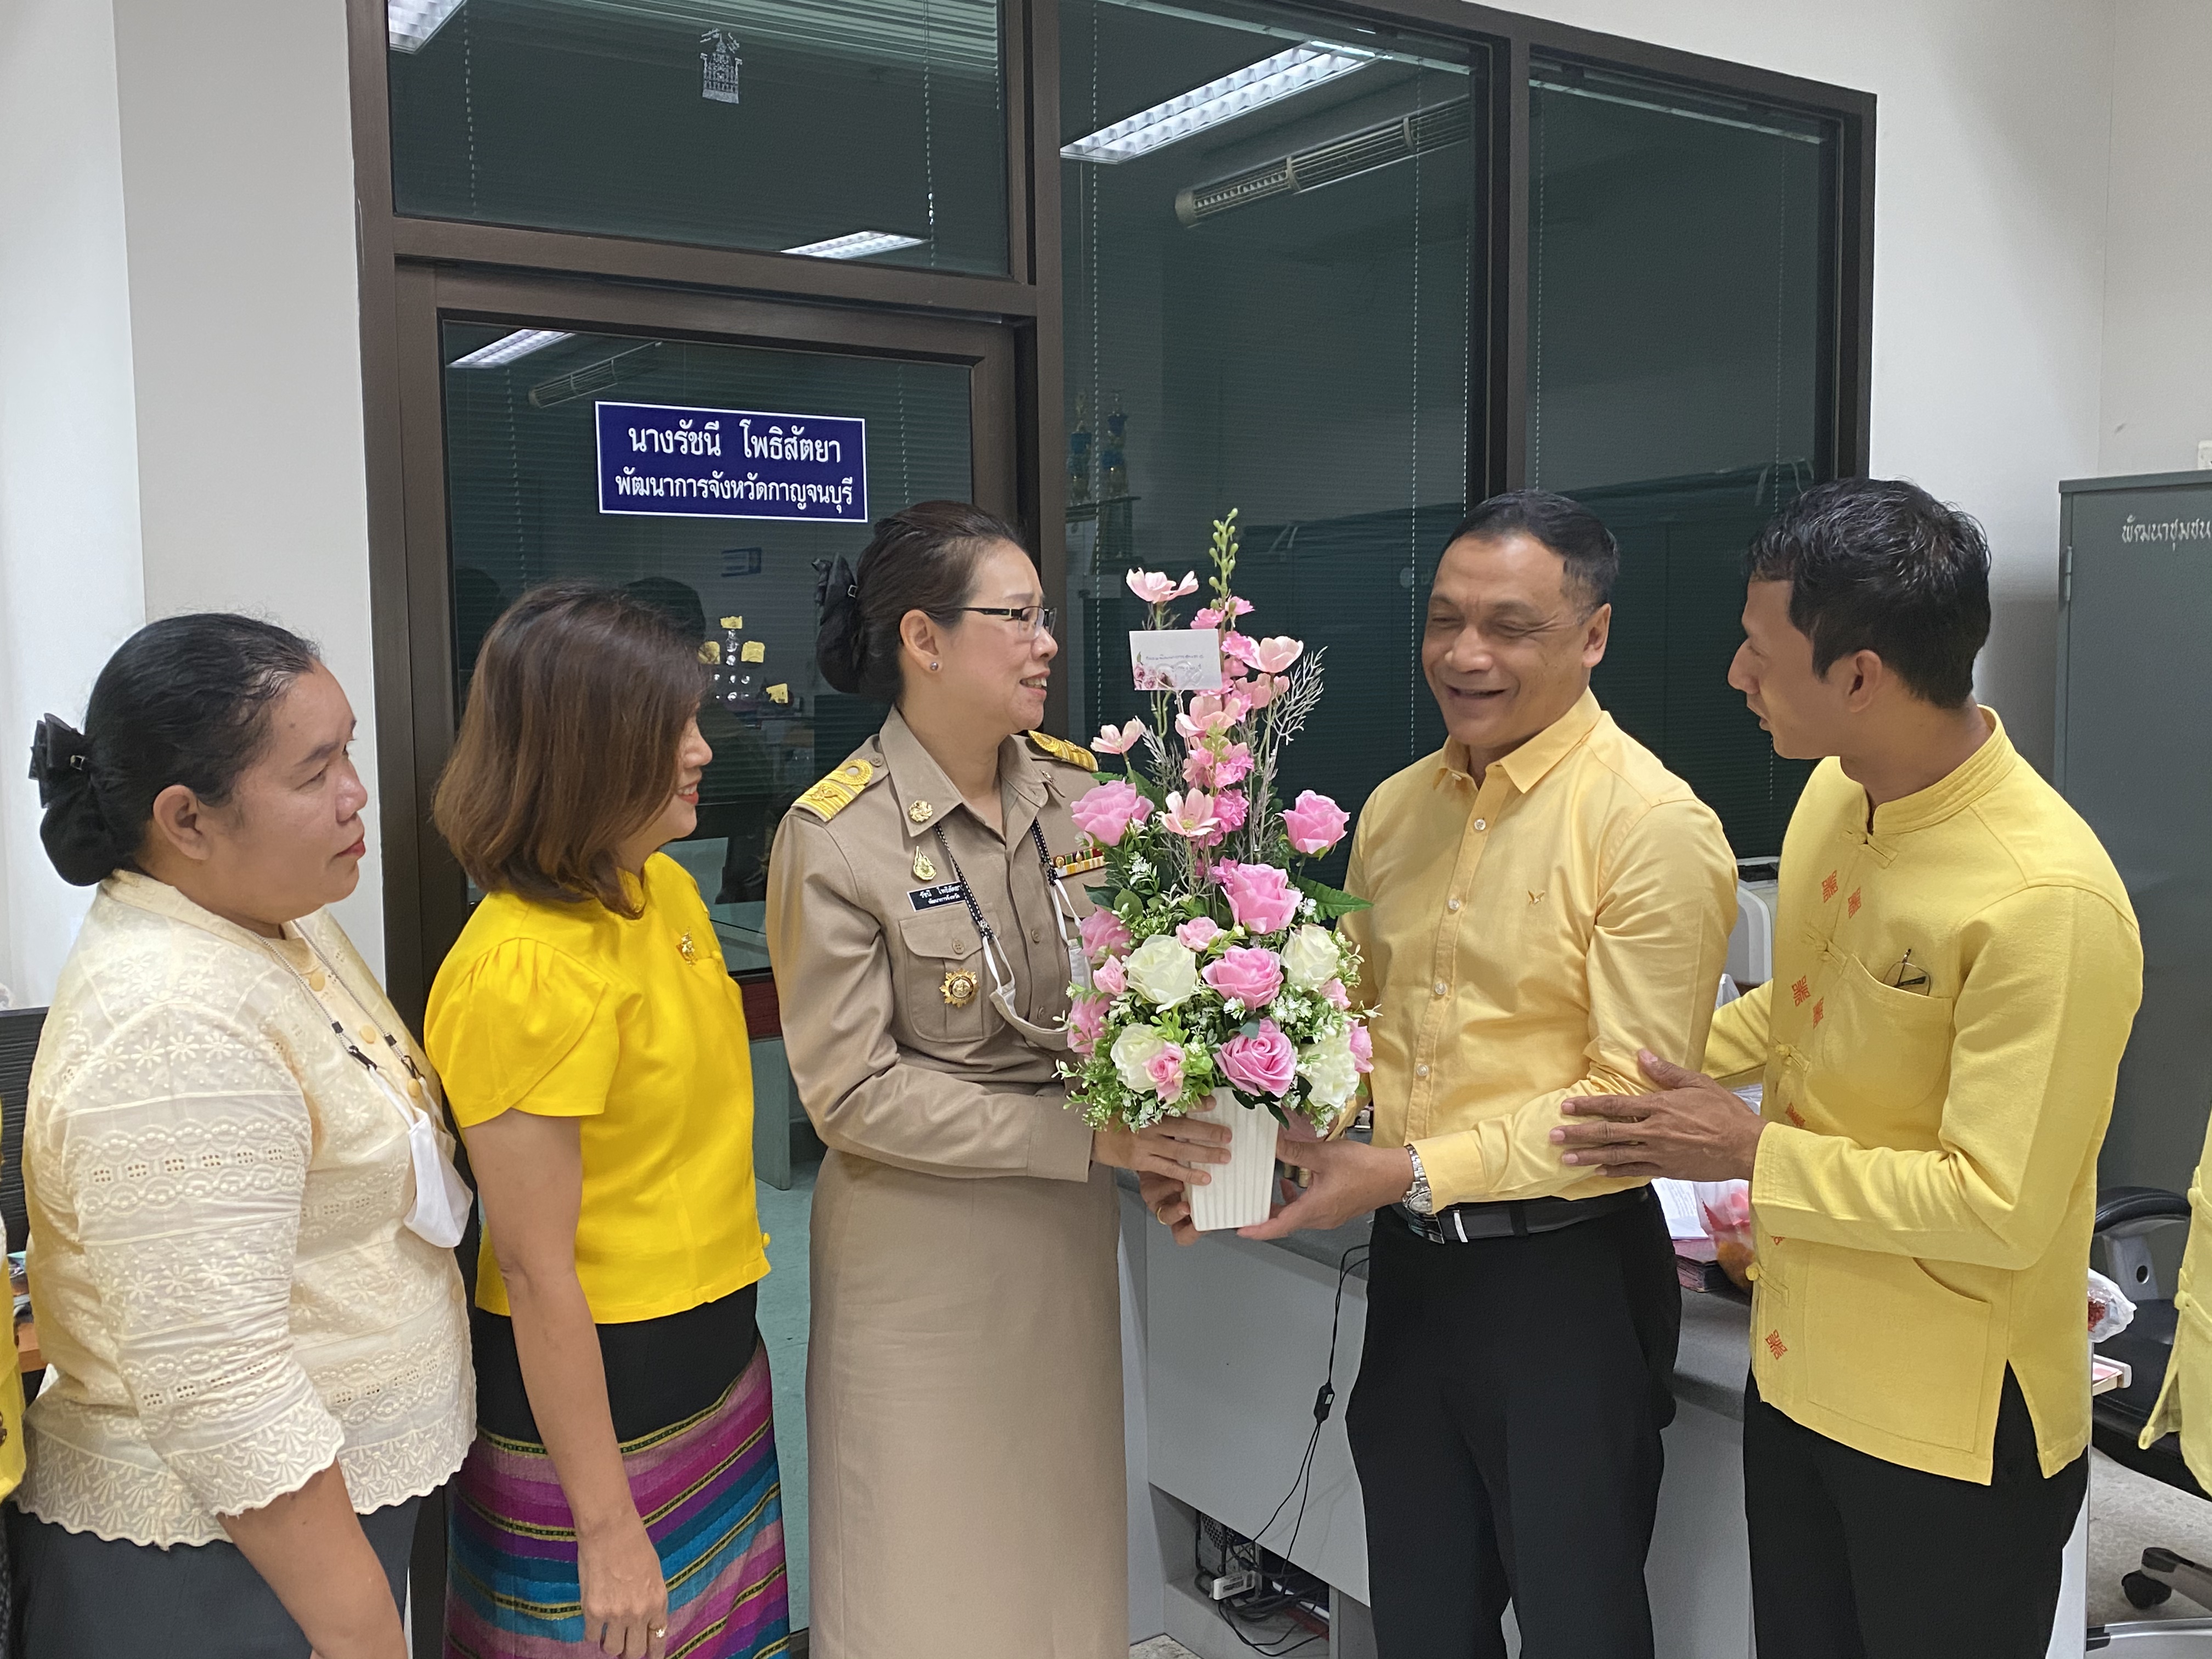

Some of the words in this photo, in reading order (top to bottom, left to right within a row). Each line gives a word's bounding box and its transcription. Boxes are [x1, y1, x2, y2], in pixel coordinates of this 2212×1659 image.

[628, 419, 721, 456] นางรัชนี
[739, 419, 841, 463] โพธิสัตยา
[615, 466, 853, 514] พัฒนาการจังหวัดกาญจนบุรี
[2121, 514, 2211, 551] พัฒนาชุมชน
